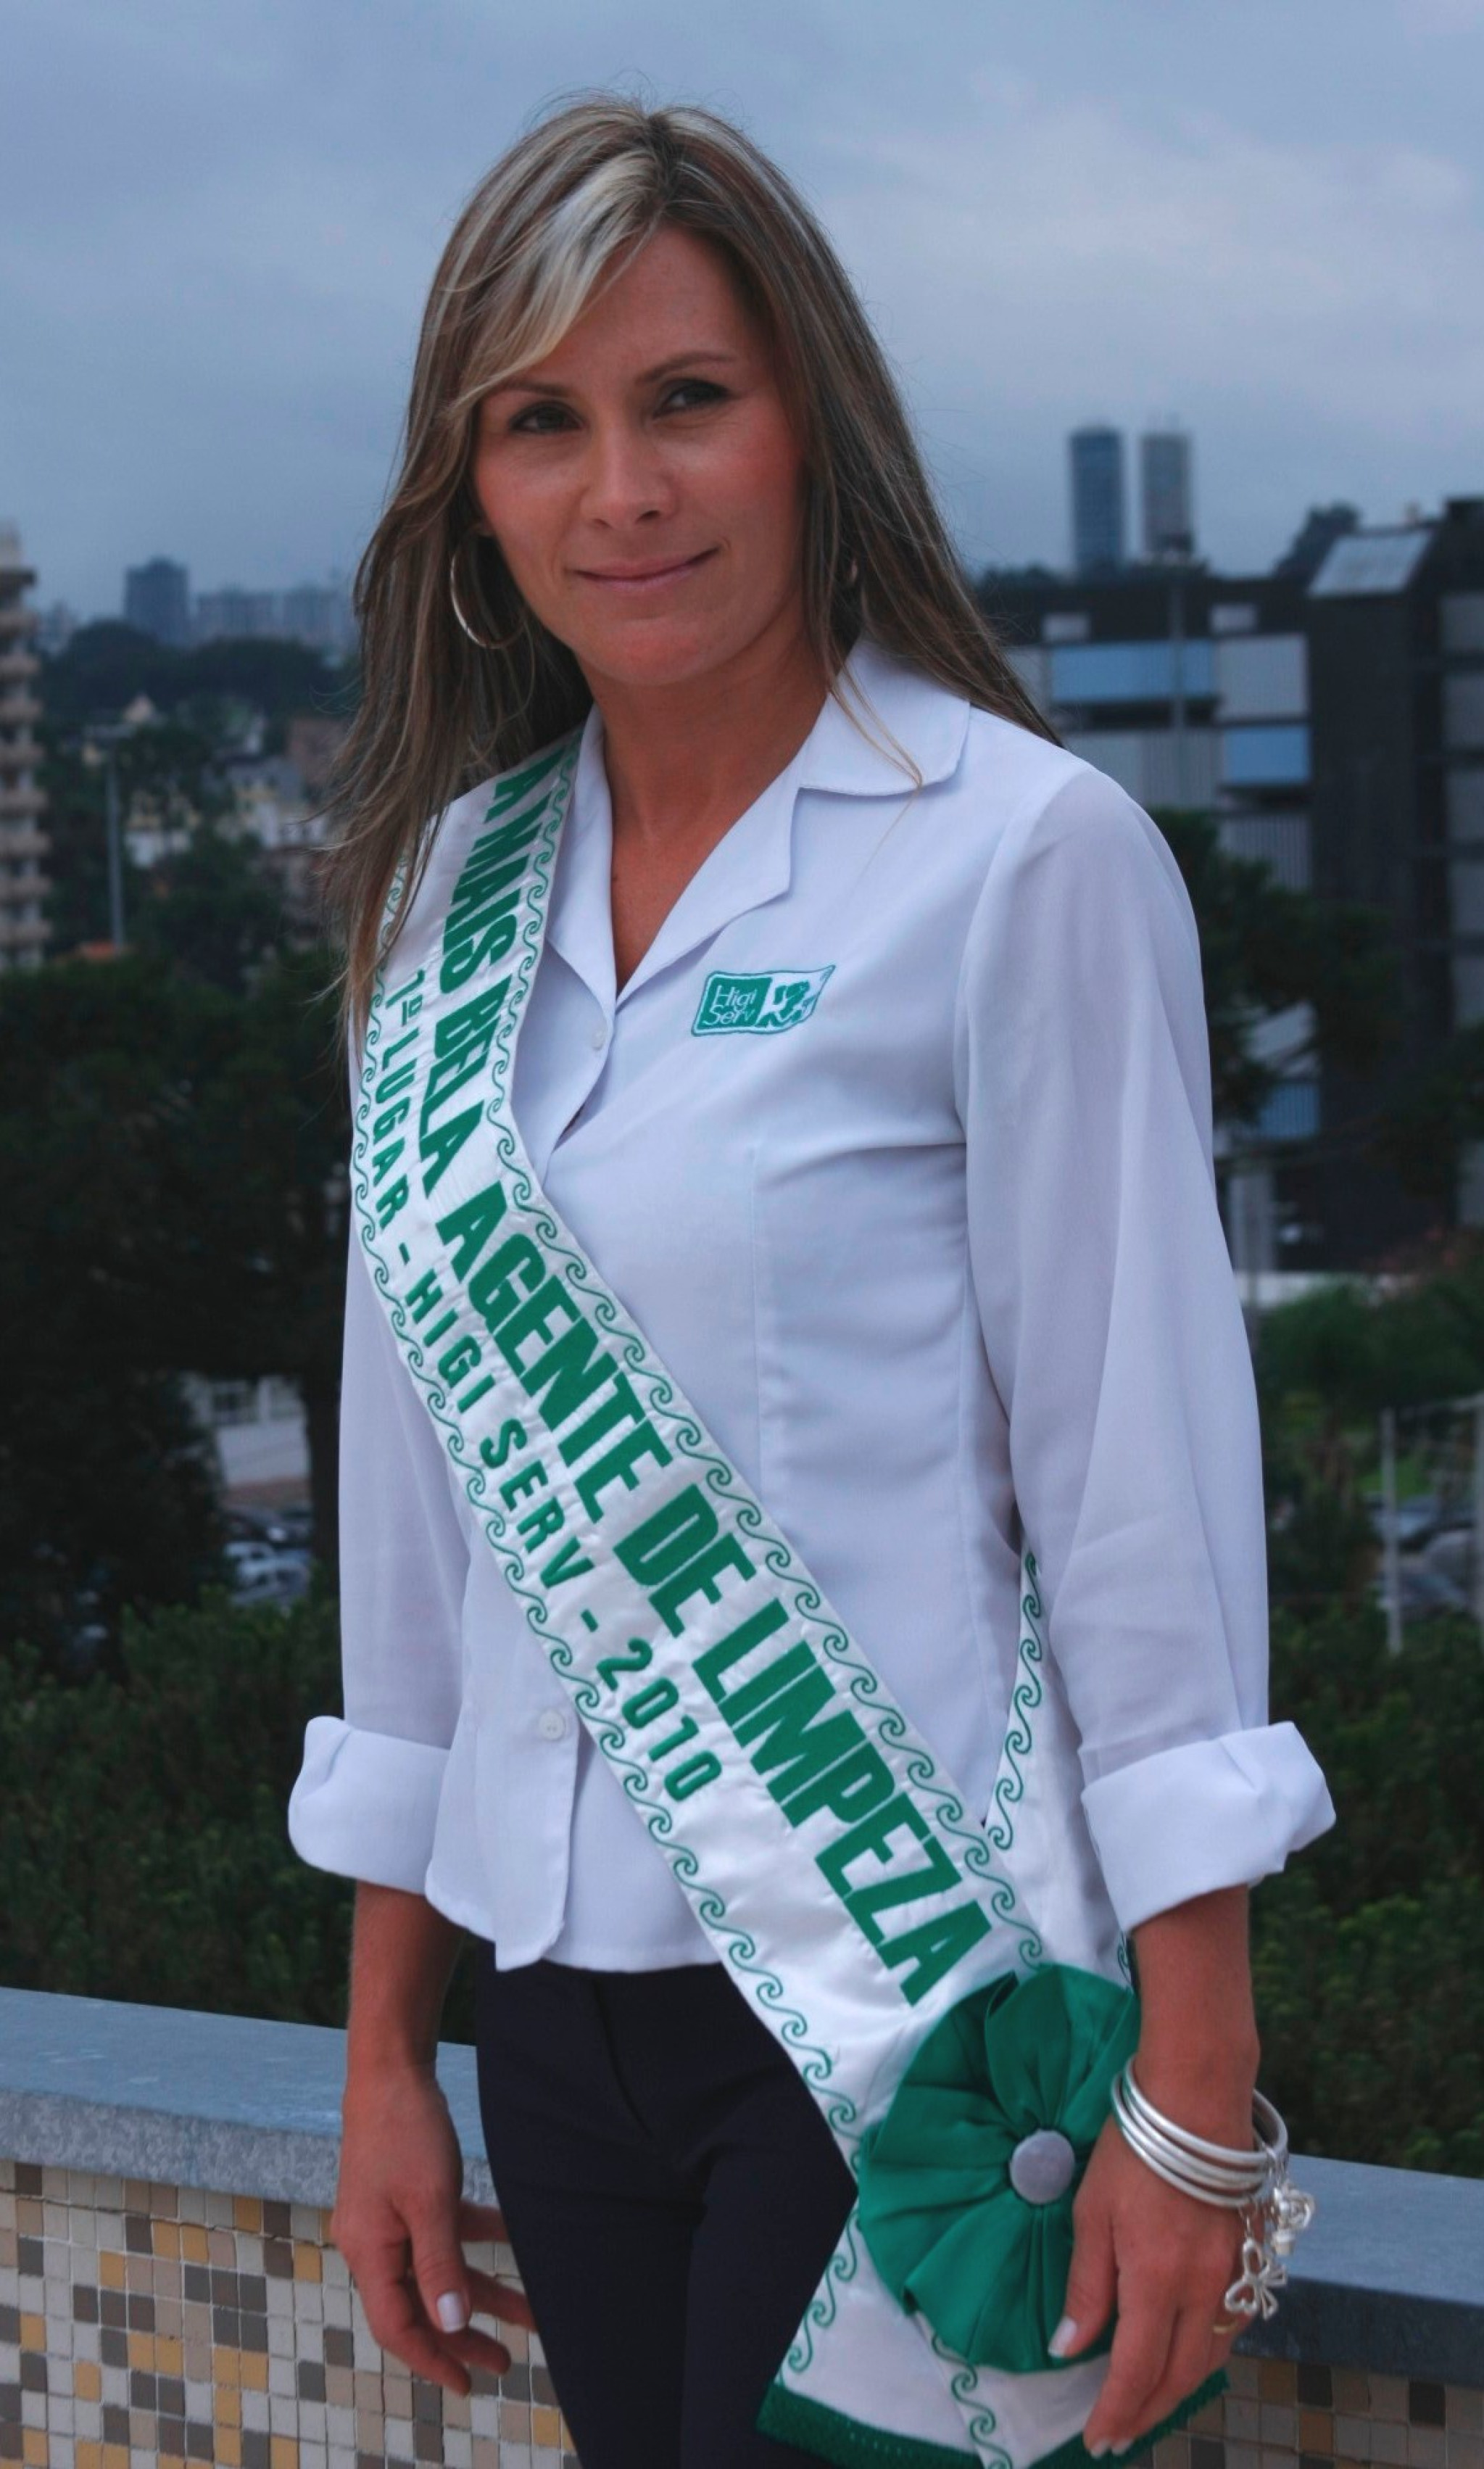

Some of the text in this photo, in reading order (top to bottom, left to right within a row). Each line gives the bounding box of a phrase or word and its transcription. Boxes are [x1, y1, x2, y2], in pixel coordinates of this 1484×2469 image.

[418, 745, 992, 2007] A MAIS BELA AGENTE DE LIMPEZA
[702, 1004, 755, 1025] Serv
[372, 1027, 420, 1228] LUGAR
[405, 1269, 495, 1413] HIGI
[479, 1418, 594, 1589] SERV
[597, 1637, 722, 1803] 2010
